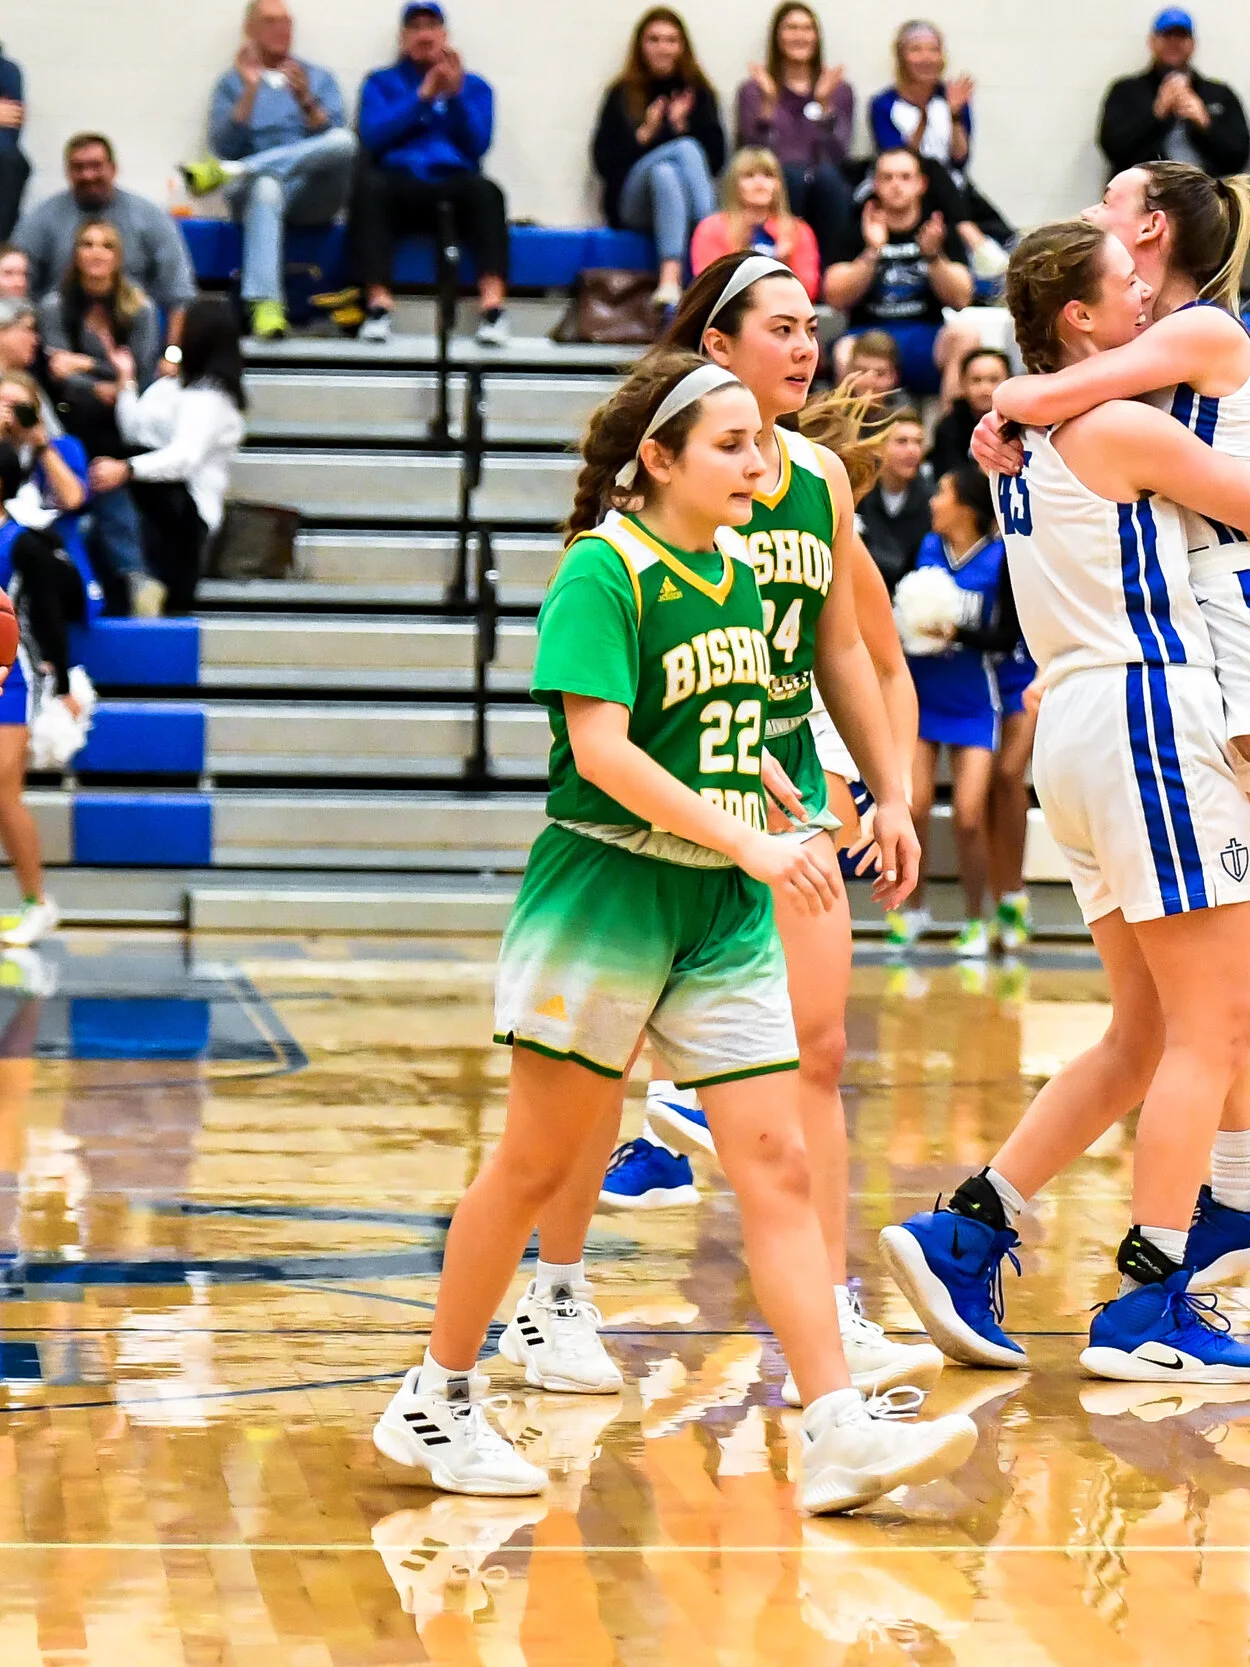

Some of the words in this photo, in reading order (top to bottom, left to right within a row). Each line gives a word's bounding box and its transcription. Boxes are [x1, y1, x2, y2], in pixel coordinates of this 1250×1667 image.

[746, 529, 833, 598] SHOP
[662, 626, 771, 711] BISHO
[699, 700, 761, 776] 22
